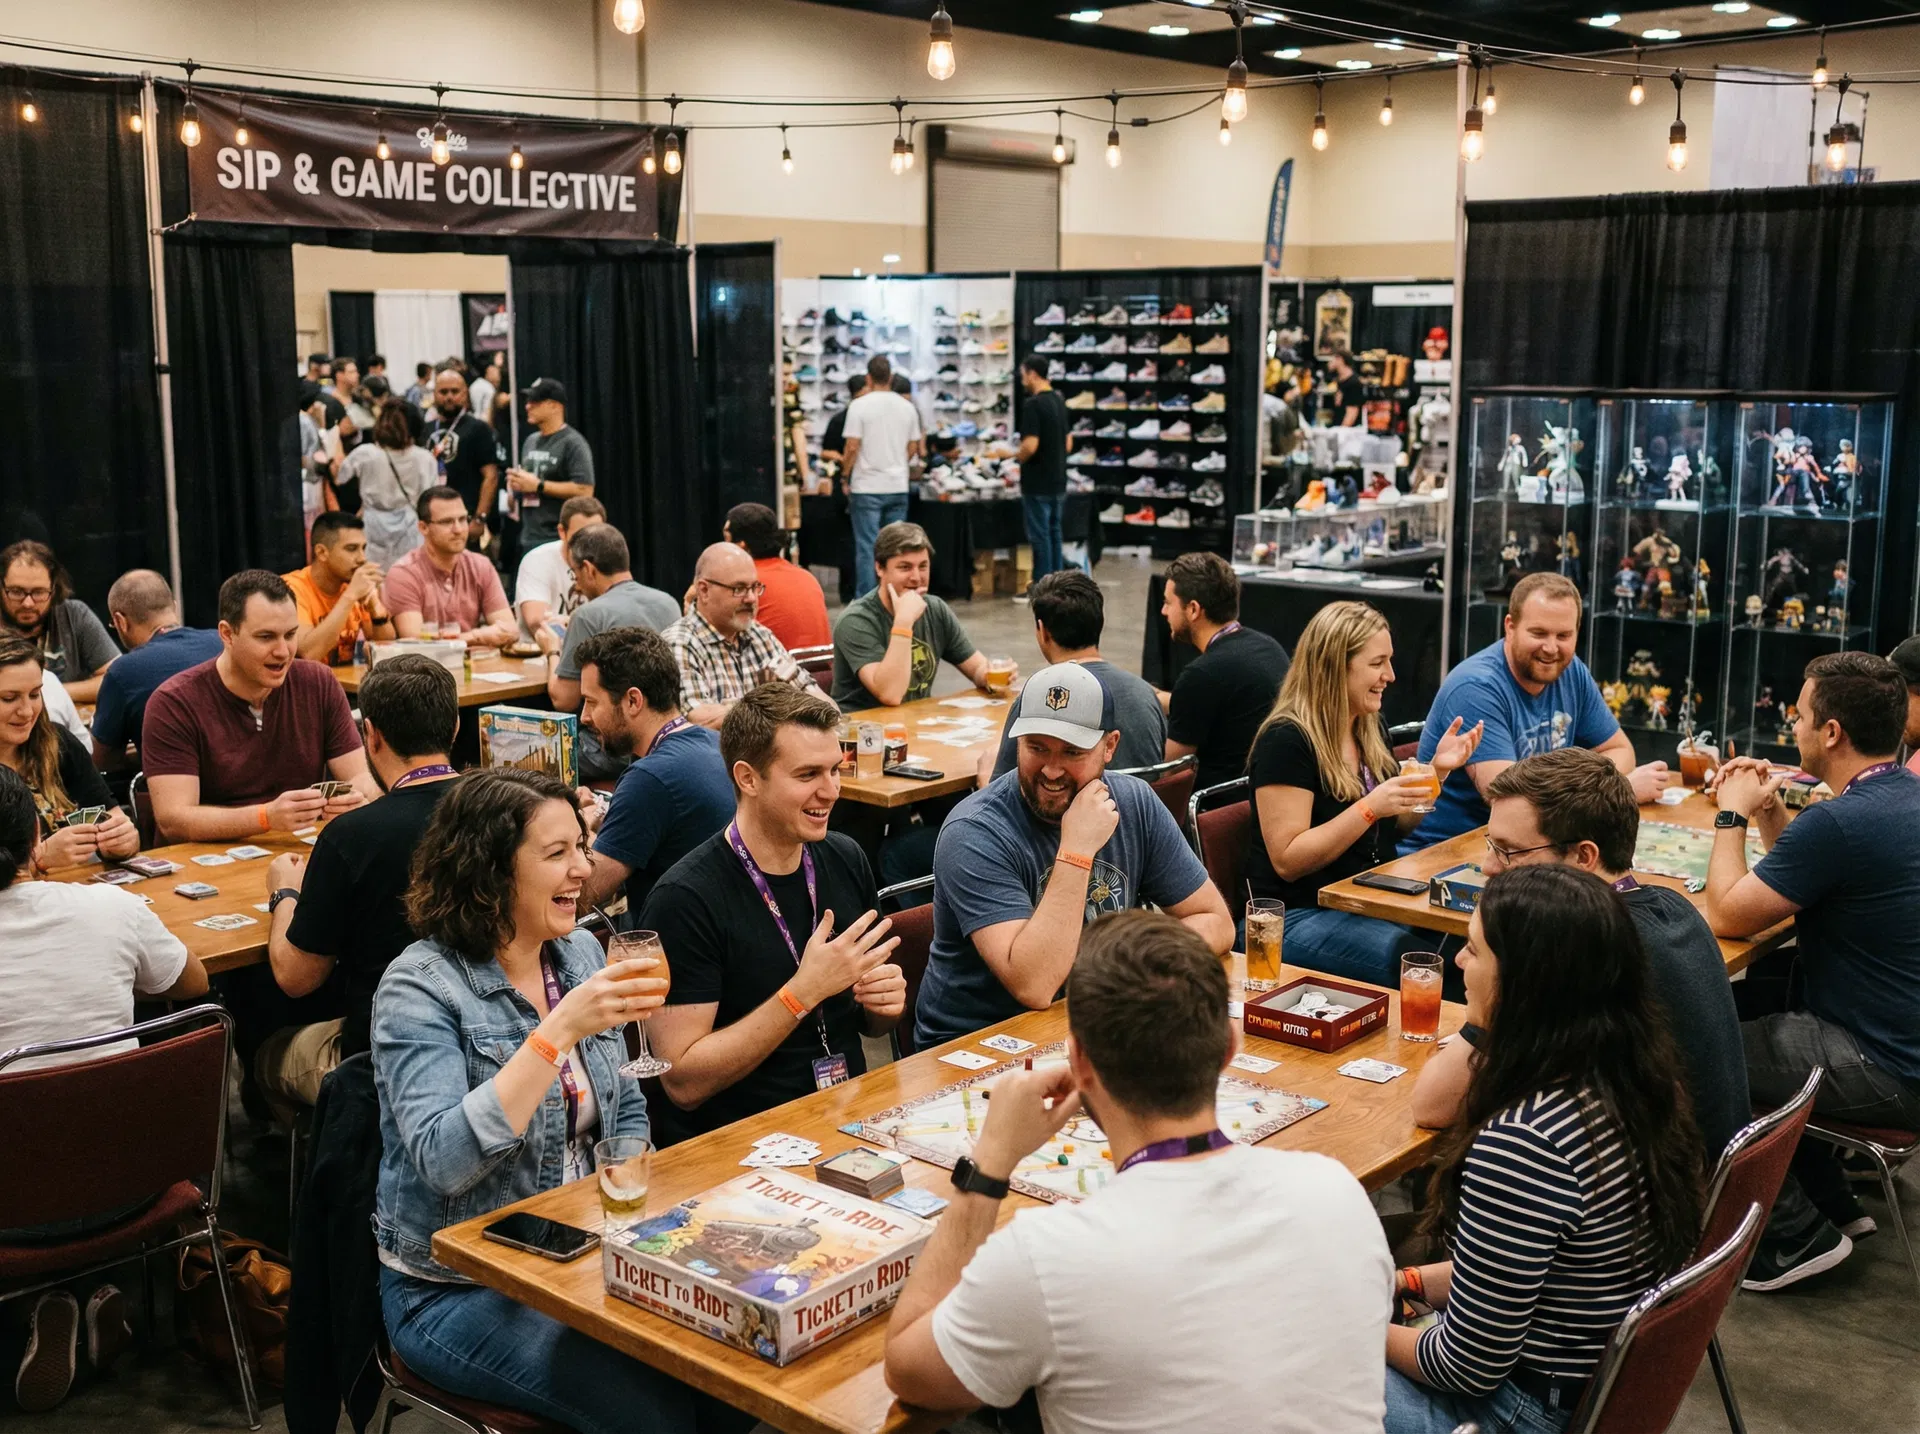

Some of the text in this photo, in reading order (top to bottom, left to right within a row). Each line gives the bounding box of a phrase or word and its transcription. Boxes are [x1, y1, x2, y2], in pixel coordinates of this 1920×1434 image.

[216, 146, 637, 213] SIP & GAME COLLECTIVE
[745, 1176, 829, 1212] TICKET
[823, 1206, 846, 1217] TO
[843, 1209, 904, 1239] RIDE
[612, 1251, 735, 1326] TICKET TO RIDE
[793, 1254, 915, 1336] TICKET TO RIDE
